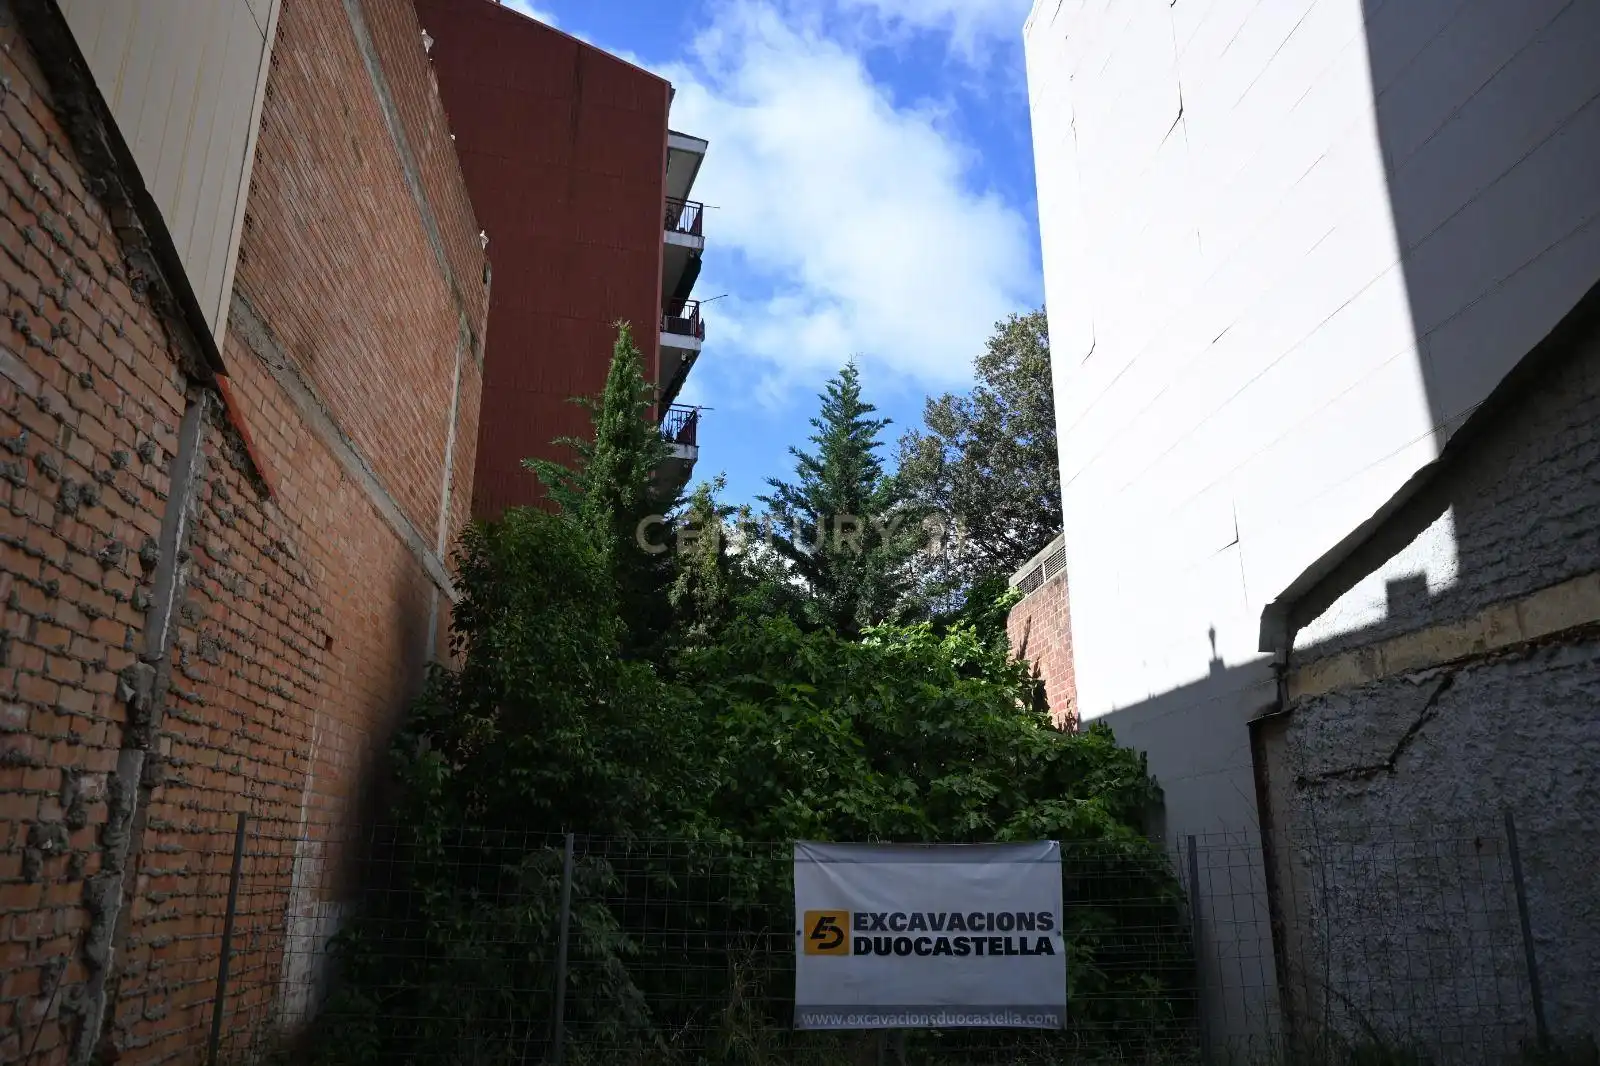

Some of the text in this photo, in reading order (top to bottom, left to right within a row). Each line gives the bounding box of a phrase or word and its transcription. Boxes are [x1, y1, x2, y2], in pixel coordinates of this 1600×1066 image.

[853, 911, 1055, 932] EXCAVACIONS
[853, 936, 1056, 956] DUOCASTELLA
[801, 1010, 1059, 1026] www.excavacionsduocastella.com
